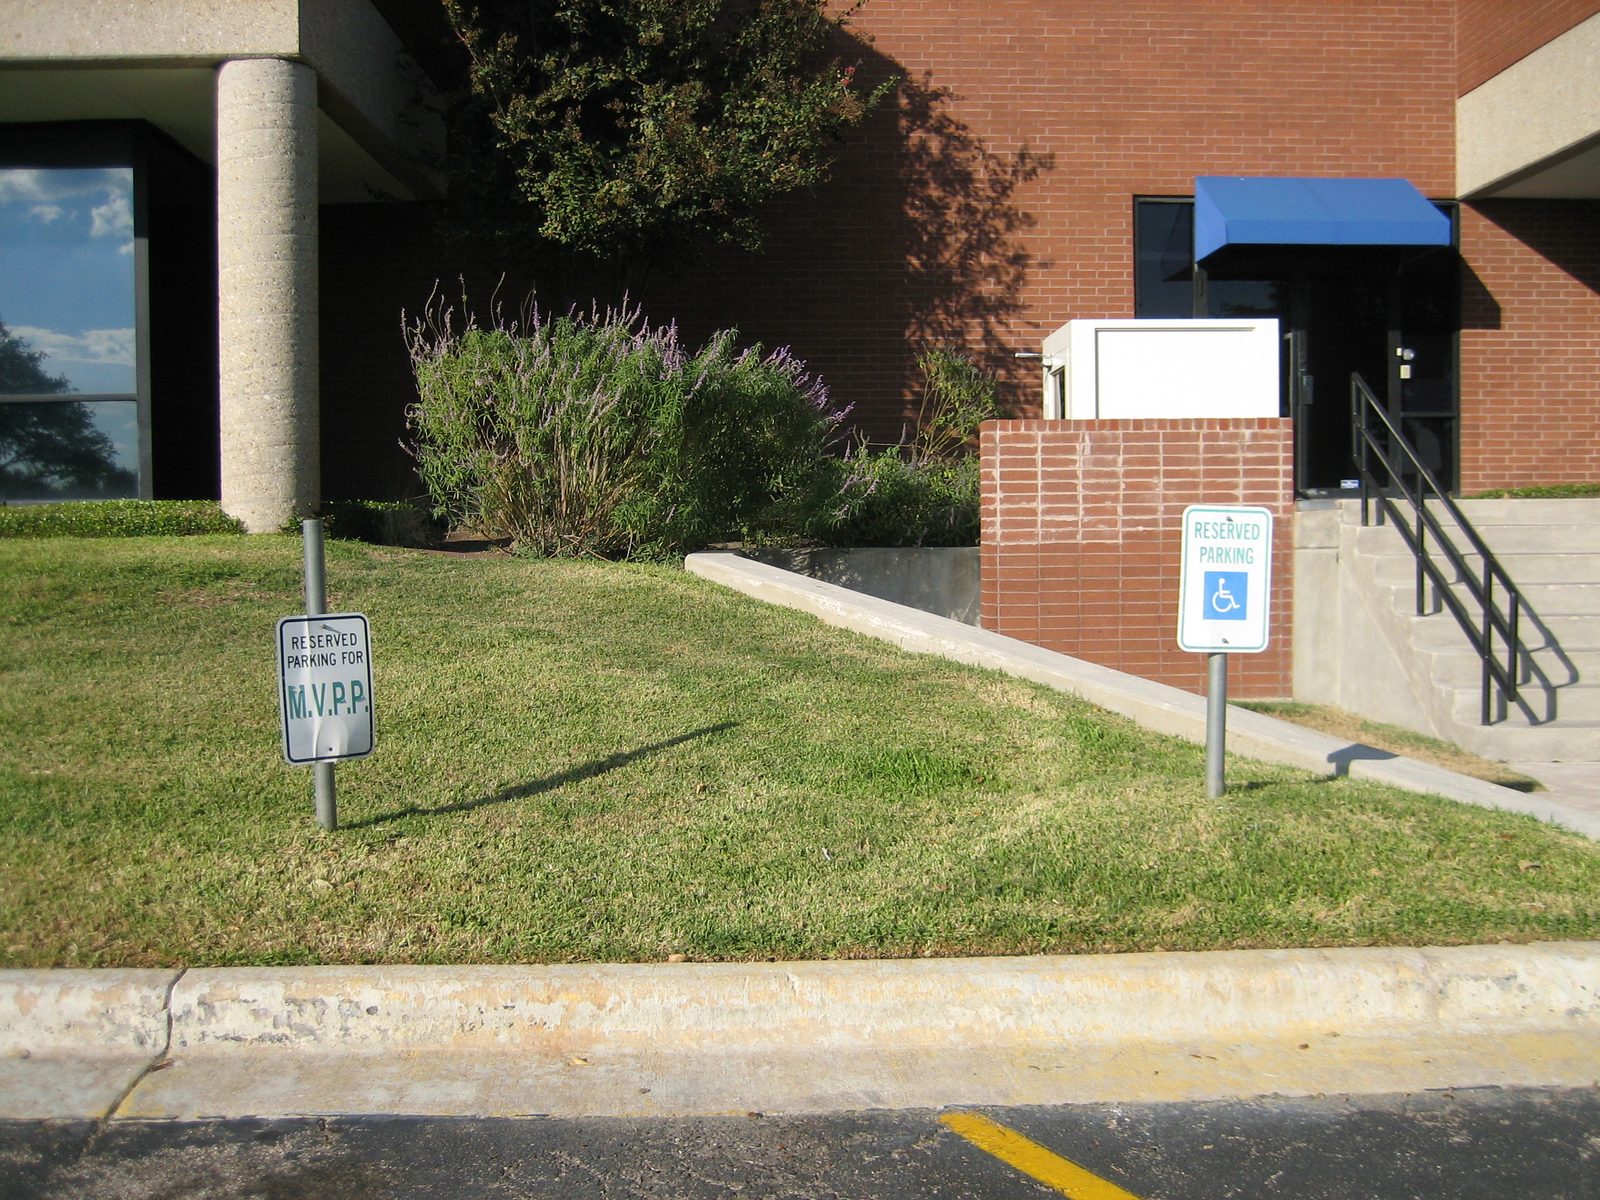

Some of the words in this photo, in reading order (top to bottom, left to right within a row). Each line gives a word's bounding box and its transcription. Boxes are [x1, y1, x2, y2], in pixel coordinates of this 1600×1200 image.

[1194, 521, 1260, 540] RESERVED
[1199, 546, 1254, 564] PARKING
[291, 632, 357, 650] RESERVED
[287, 652, 337, 669] PARKING
[341, 650, 364, 665] FOR
